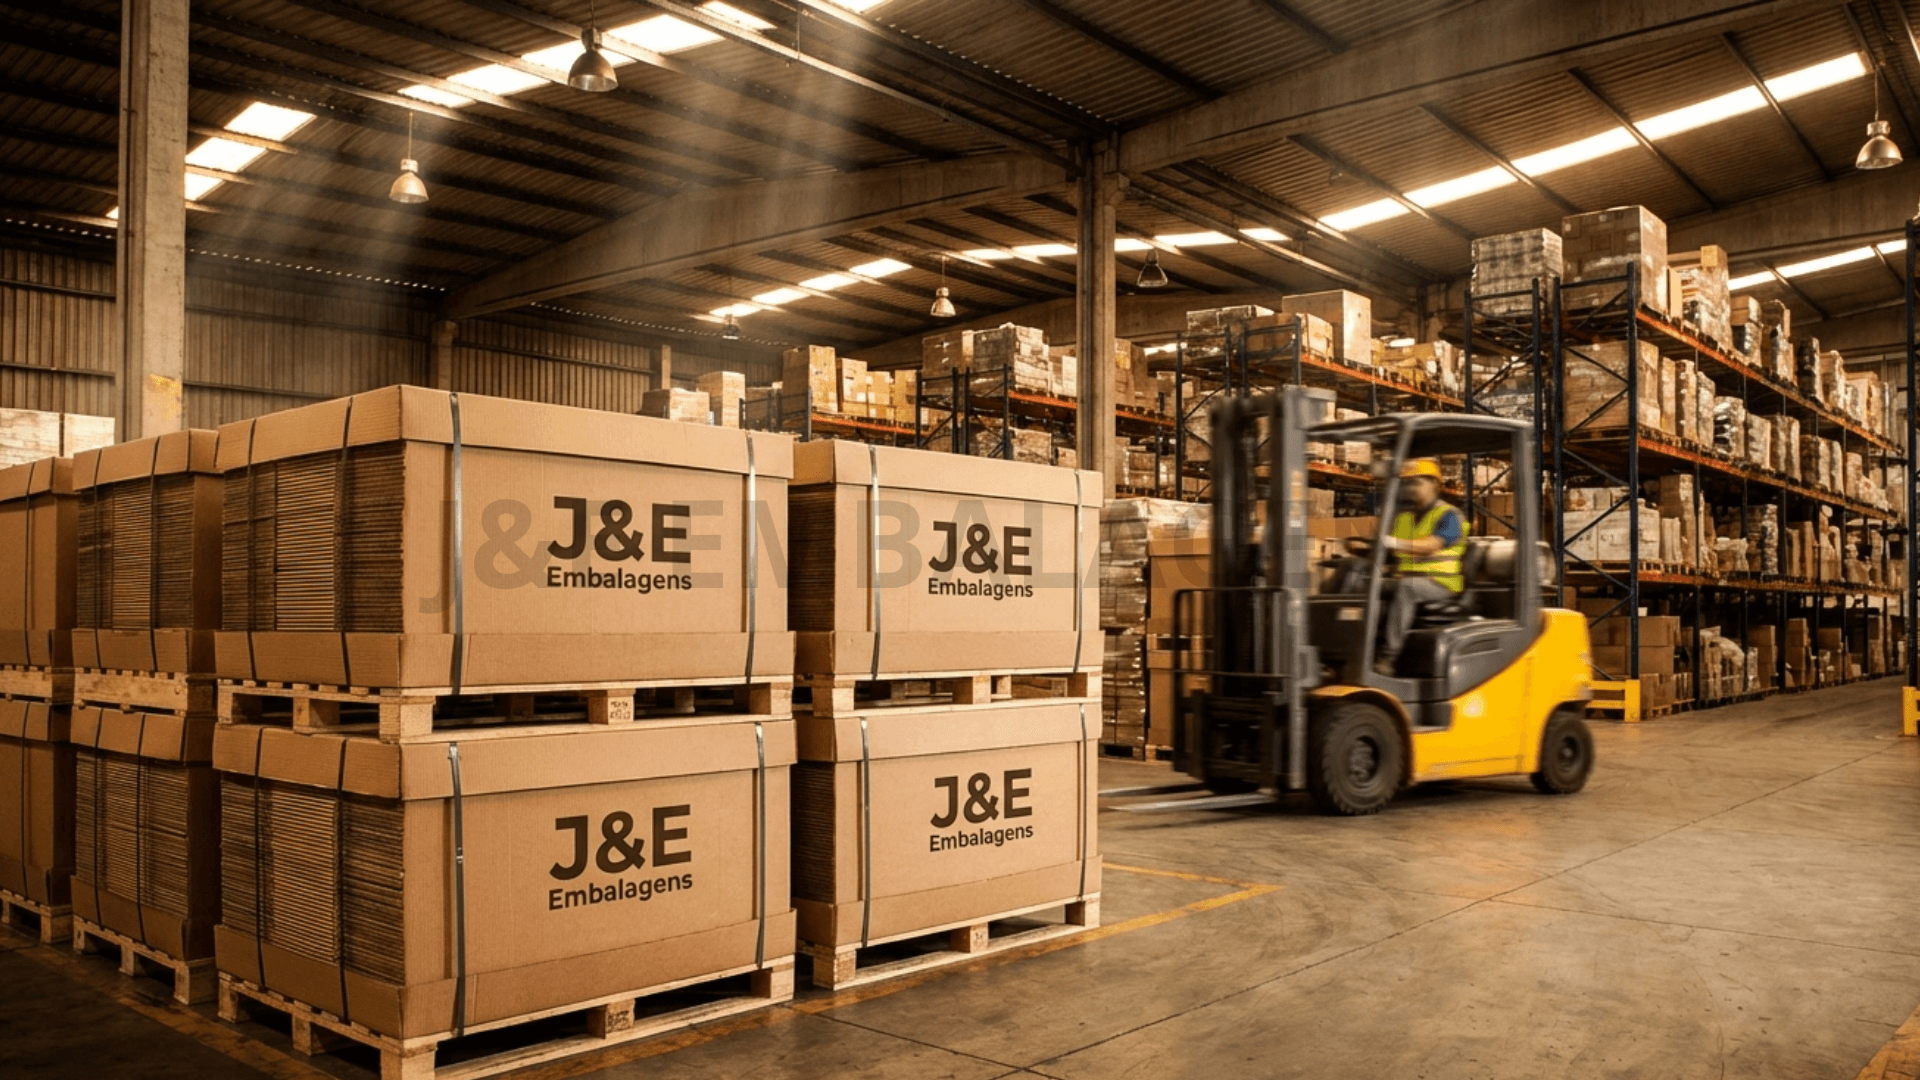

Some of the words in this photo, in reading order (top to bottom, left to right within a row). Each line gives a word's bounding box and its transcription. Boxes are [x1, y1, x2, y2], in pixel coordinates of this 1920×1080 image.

[547, 496, 691, 563] J&E
[928, 521, 1033, 575] J&E
[547, 566, 692, 595] Embalagens
[928, 577, 1034, 601] Embalagens
[930, 768, 1033, 829] J&E
[549, 804, 692, 881] J&E
[929, 825, 1034, 853] Embalagens
[548, 873, 693, 911] Embalagens
